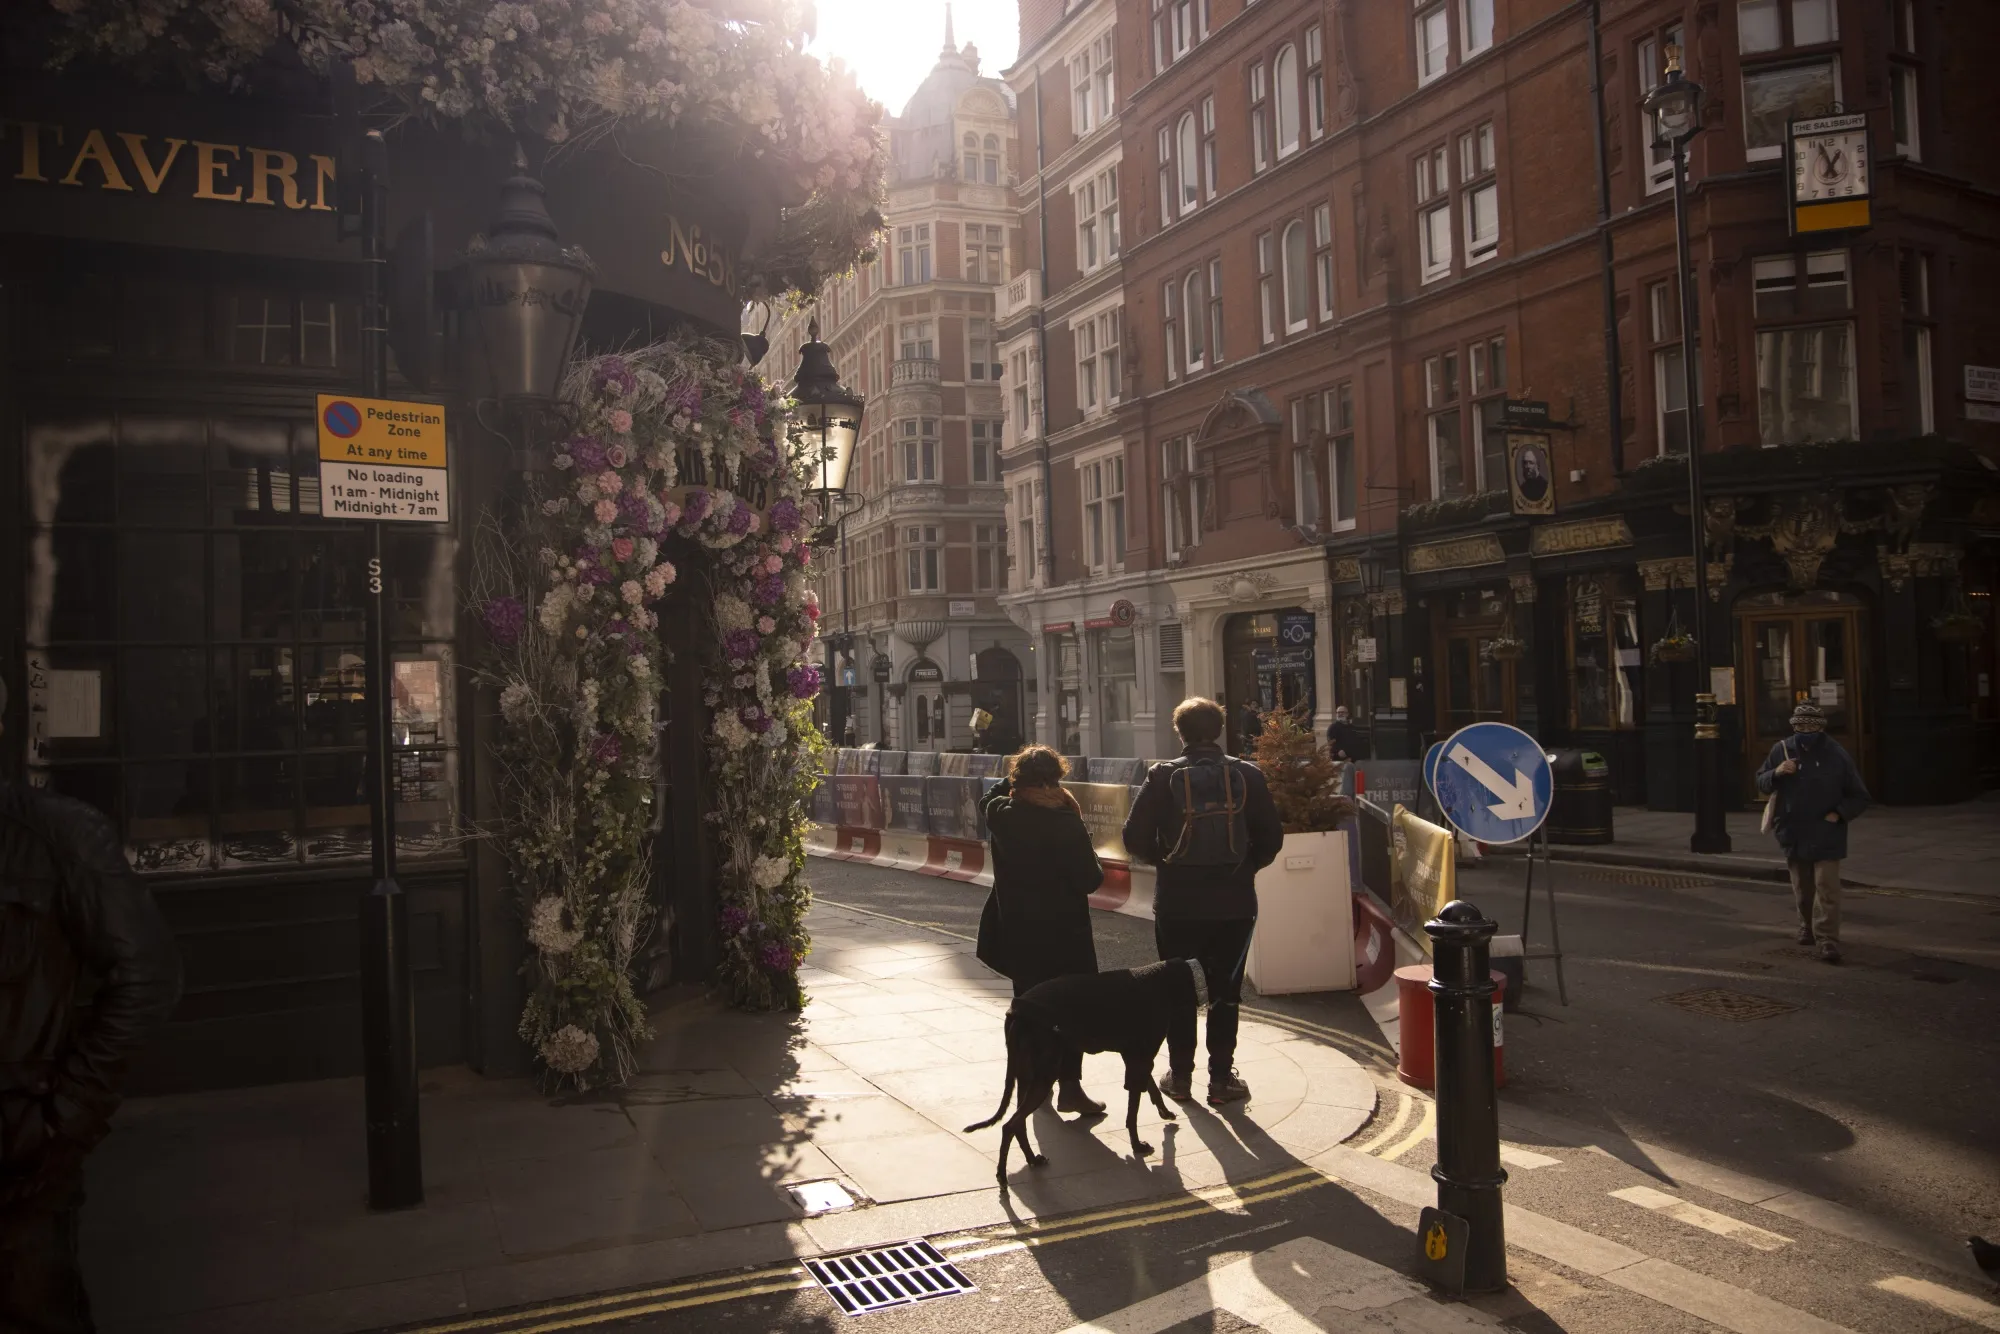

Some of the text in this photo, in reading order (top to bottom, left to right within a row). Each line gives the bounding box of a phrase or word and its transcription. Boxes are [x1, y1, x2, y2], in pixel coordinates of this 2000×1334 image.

[1794, 117, 1864, 133] THE SALISBURY
[1824, 138, 1835, 147] 12
[1857, 144, 1865, 153] 2
[1857, 160, 1865, 168] 3
[1858, 176, 1865, 184] 4
[1812, 190, 1819, 198] 7
[1828, 188, 1836, 197] 6
[1845, 186, 1853, 195] 5
[1508, 405, 1530, 413] GREENE
[367, 407, 441, 425] Pedestrian
[388, 424, 421, 437] Zone
[347, 444, 428, 460] At any time
[348, 469, 423, 486] No loading
[330, 485, 342, 497] 11
[346, 488, 367, 498] am
[379, 487, 440, 503] Midnight
[334, 500, 397, 515] Midnight
[408, 503, 415, 514] 7
[418, 506, 438, 516] am
[368, 558, 382, 576] S
[369, 577, 383, 594] 3
[1375, 776, 1413, 789] SIMPLY
[1364, 790, 1418, 801] THE BEST
[1093, 804, 1103, 813] AM
